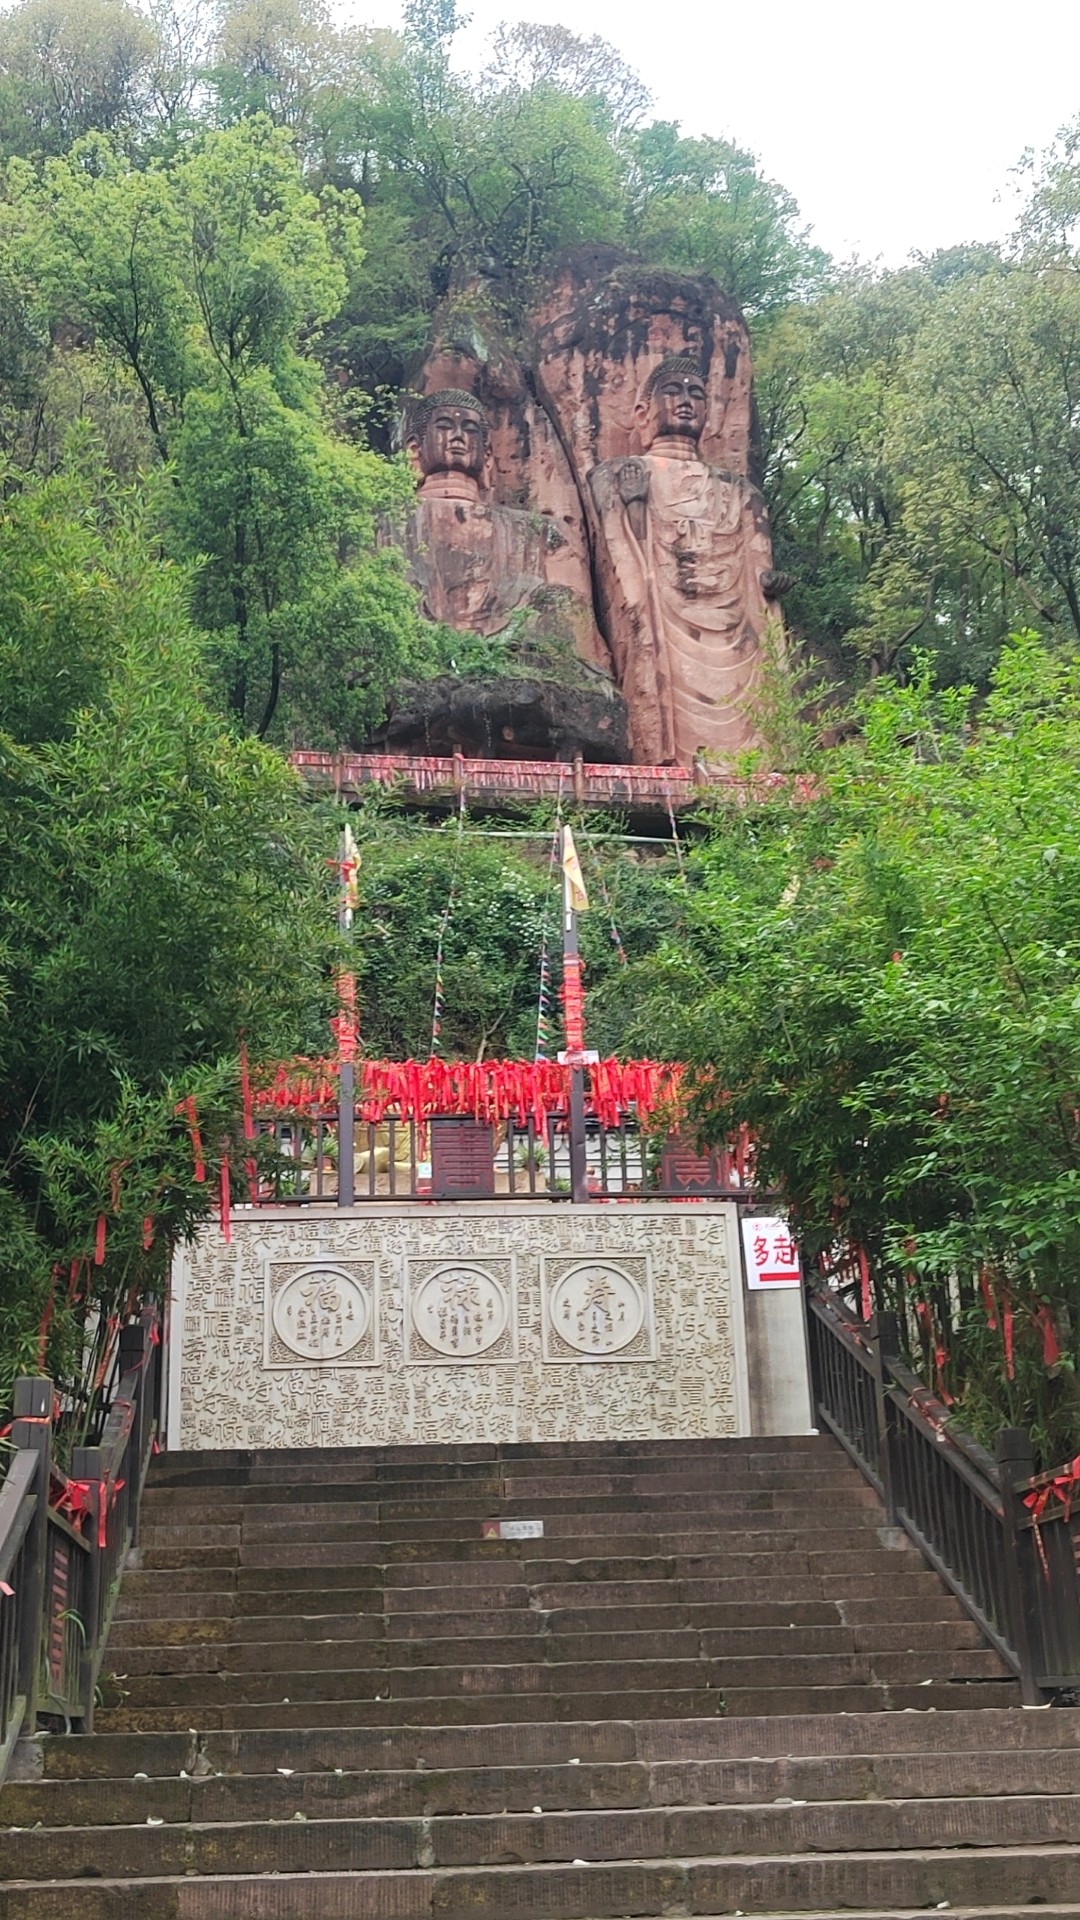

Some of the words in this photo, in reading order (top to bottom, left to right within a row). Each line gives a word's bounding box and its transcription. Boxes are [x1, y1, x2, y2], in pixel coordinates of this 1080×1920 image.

[300, 1276, 341, 1312] 福
[440, 1274, 480, 1312] 禄
[583, 1275, 616, 1313] 寿
